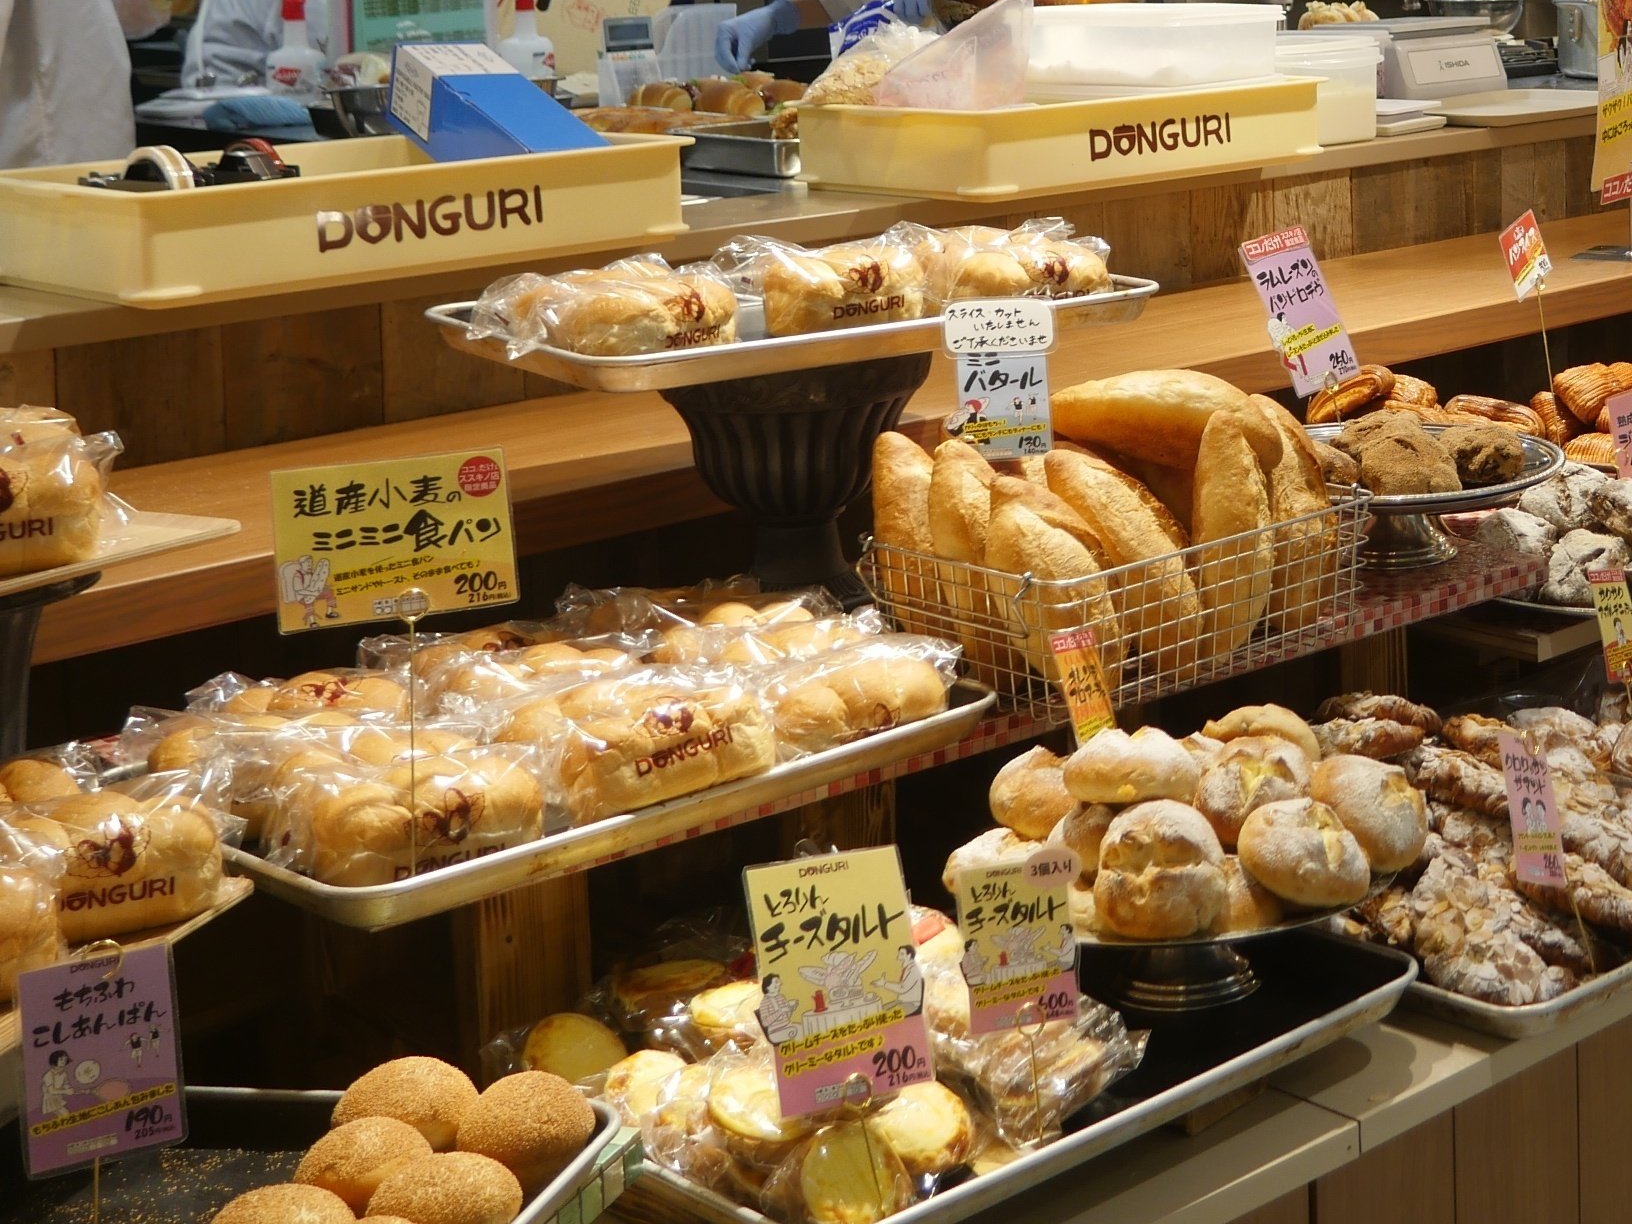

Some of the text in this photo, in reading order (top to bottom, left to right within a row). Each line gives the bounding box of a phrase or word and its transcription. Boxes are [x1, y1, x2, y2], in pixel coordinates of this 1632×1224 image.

[1444, 59, 1470, 69] ISHIDA
[1089, 111, 1232, 162] DONGURI
[317, 185, 545, 254] DONGURI
[1256, 258, 1318, 291] ラムレーズンの
[832, 296, 906, 320] DONGURI
[664, 323, 721, 349] DONGURI
[973, 319, 1040, 332] いたしません
[953, 335, 1048, 349] ご了承くださいませ
[966, 352, 1000, 367] ミニ
[964, 366, 1043, 392] バタール
[293, 475, 462, 518] 道産小麦の
[312, 508, 502, 553] ミニミニ食パン
[333, 555, 434, 582] 道産小麦を使ったミニ食パン
[454, 570, 507, 595] 200円
[634, 728, 734, 778] DONGURI
[798, 860, 849, 878] DONGURI
[1030, 859, 1072, 877] 3個入り
[764, 884, 829, 918] とろりん
[970, 881, 1017, 904] とろりん
[965, 896, 1067, 935] チーズタルト
[760, 902, 905, 964] チーズタルト
[53, 977, 135, 1012] もちふわ
[33, 1001, 167, 1049] こしあんぱん
[873, 1045, 926, 1078] 200円
[124, 1105, 172, 1132] 190円
